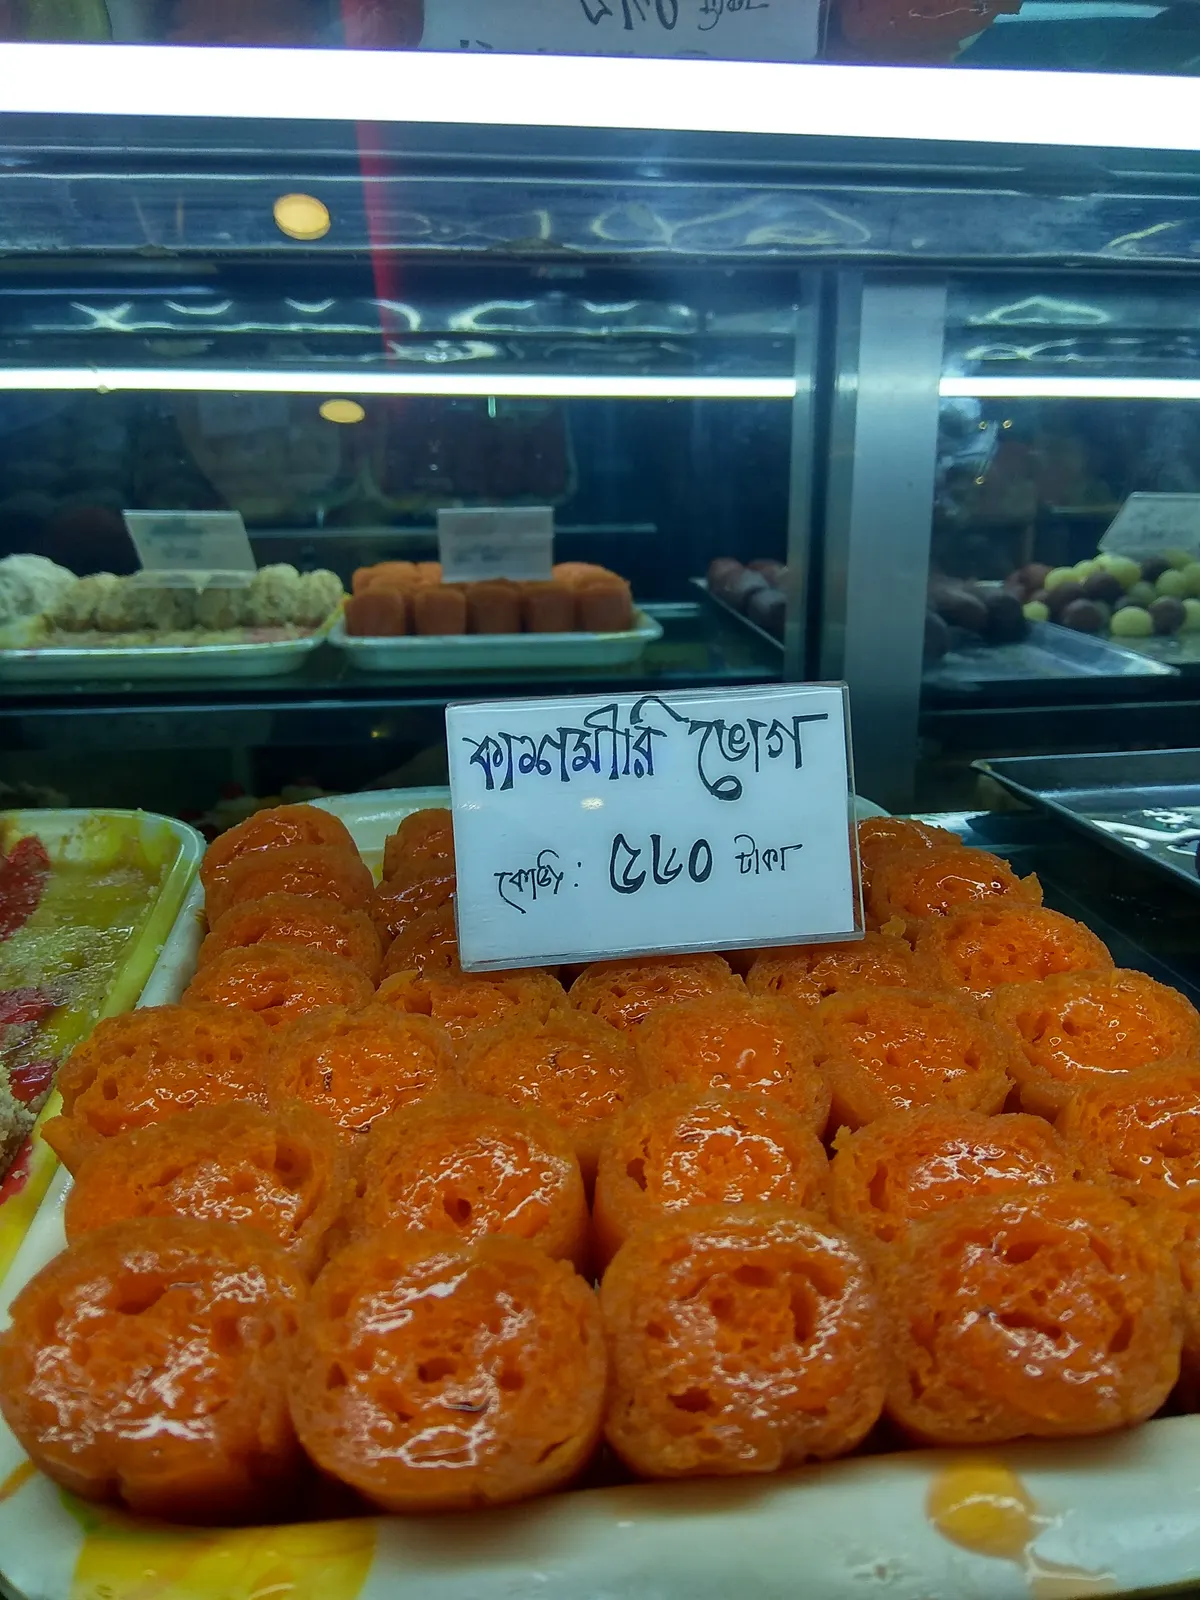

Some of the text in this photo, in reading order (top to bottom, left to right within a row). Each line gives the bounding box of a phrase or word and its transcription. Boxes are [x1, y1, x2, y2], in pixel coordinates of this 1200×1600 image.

[687, 713, 829, 801] ভোগ
[608, 833, 714, 895] ৫৬০
[733, 833, 803, 875] টাকা
